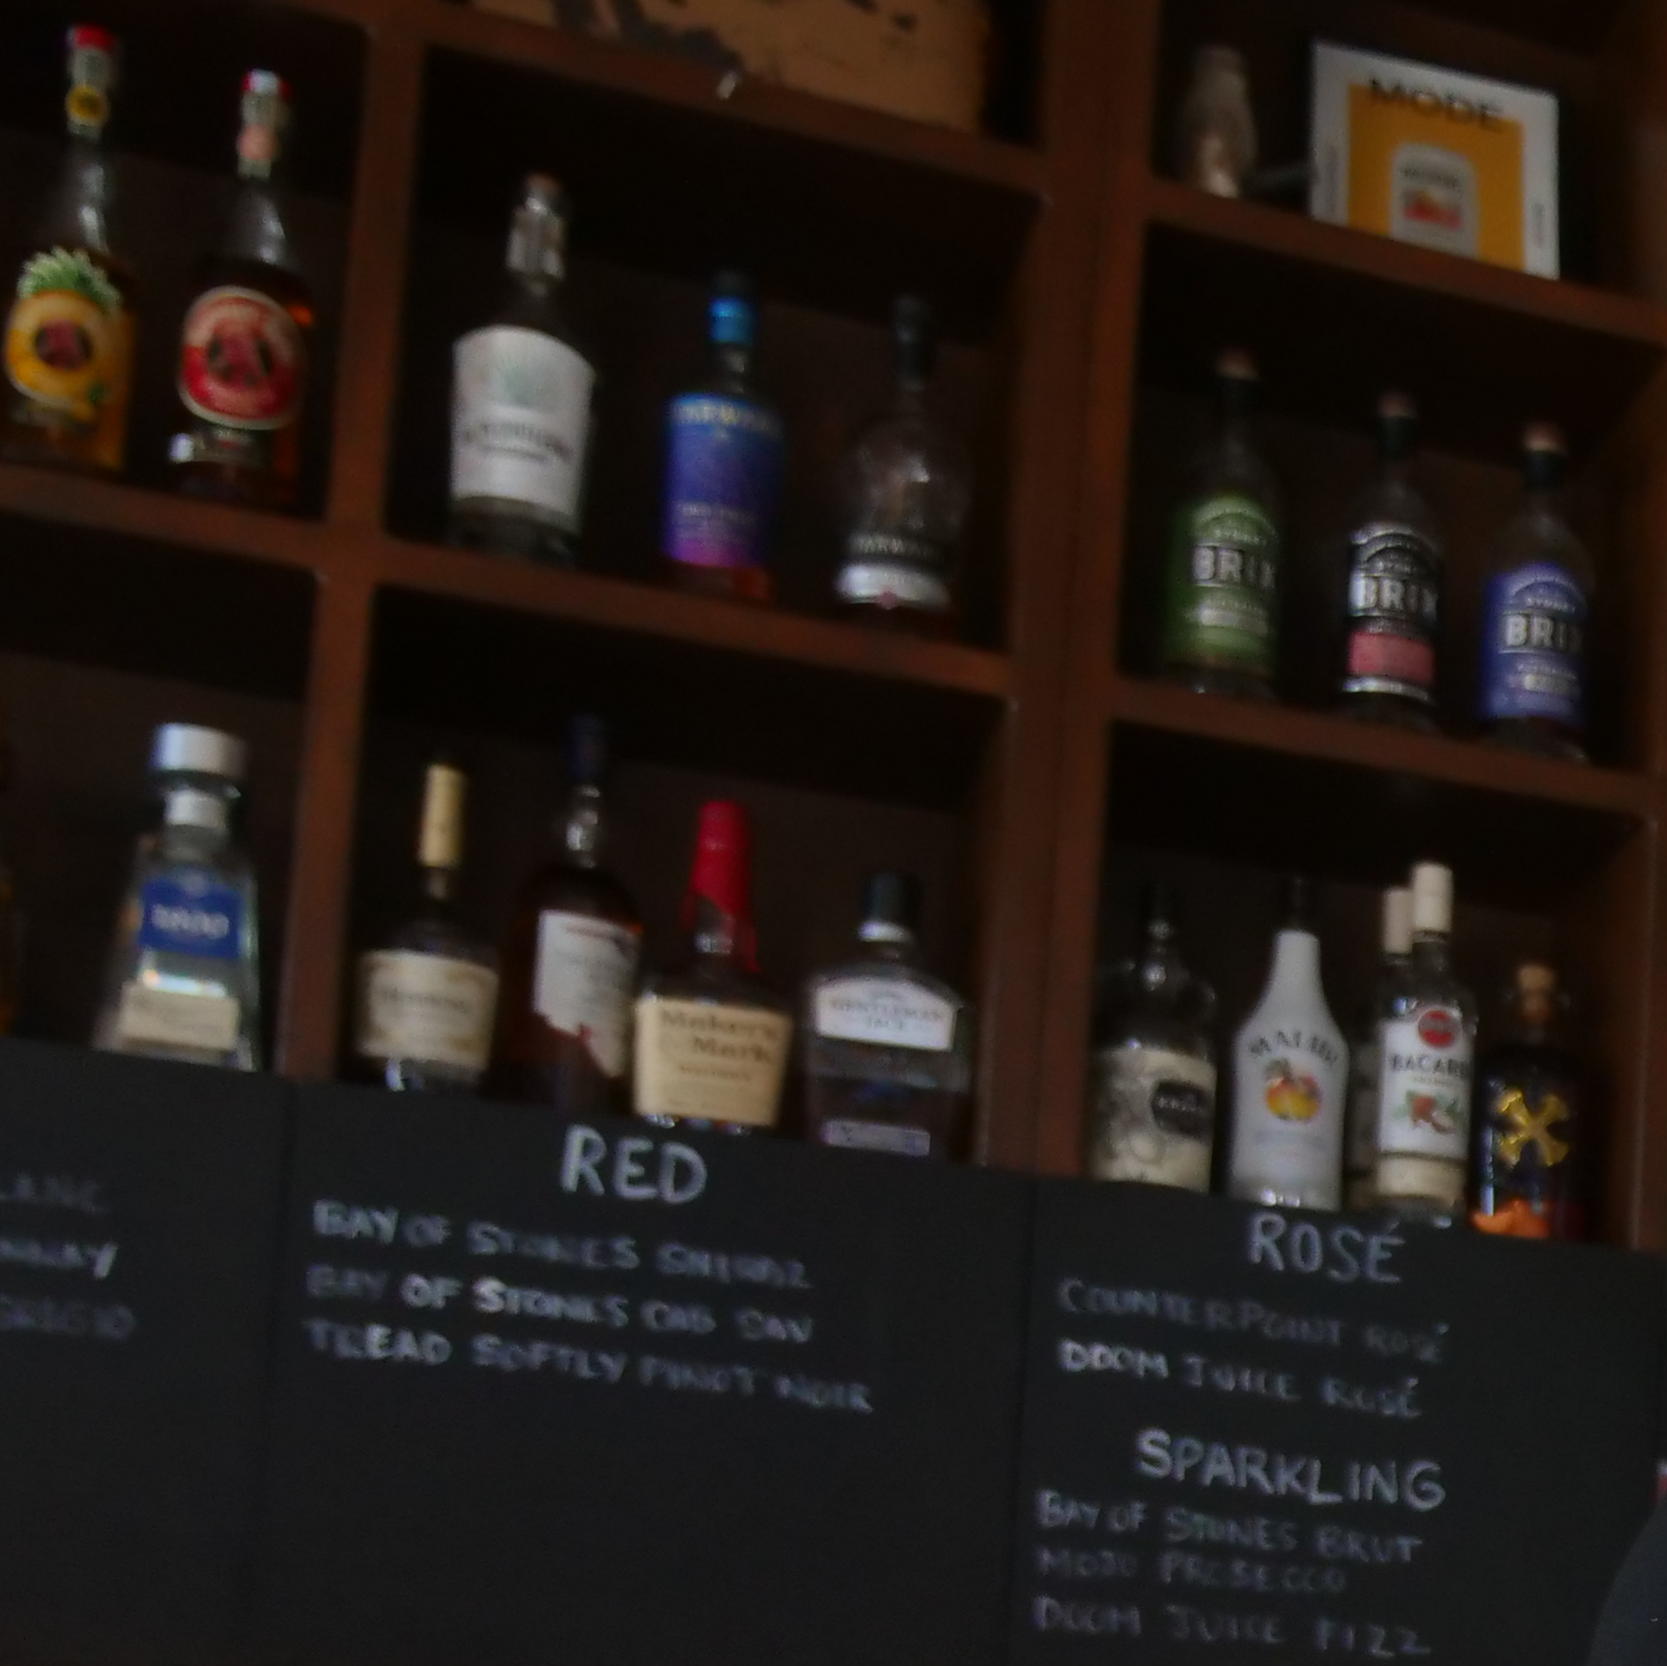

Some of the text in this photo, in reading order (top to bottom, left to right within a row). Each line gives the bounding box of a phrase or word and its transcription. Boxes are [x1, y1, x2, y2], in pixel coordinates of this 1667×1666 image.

[560, 1124, 708, 1204] RED
[1248, 1212, 1406, 1284] ROSÉ
[400, 1273, 460, 1312] OF
[1057, 1337, 1170, 1380] DOOM
[1135, 1426, 1447, 1511] SPARKLING
[1035, 1488, 1102, 1530] BAY
